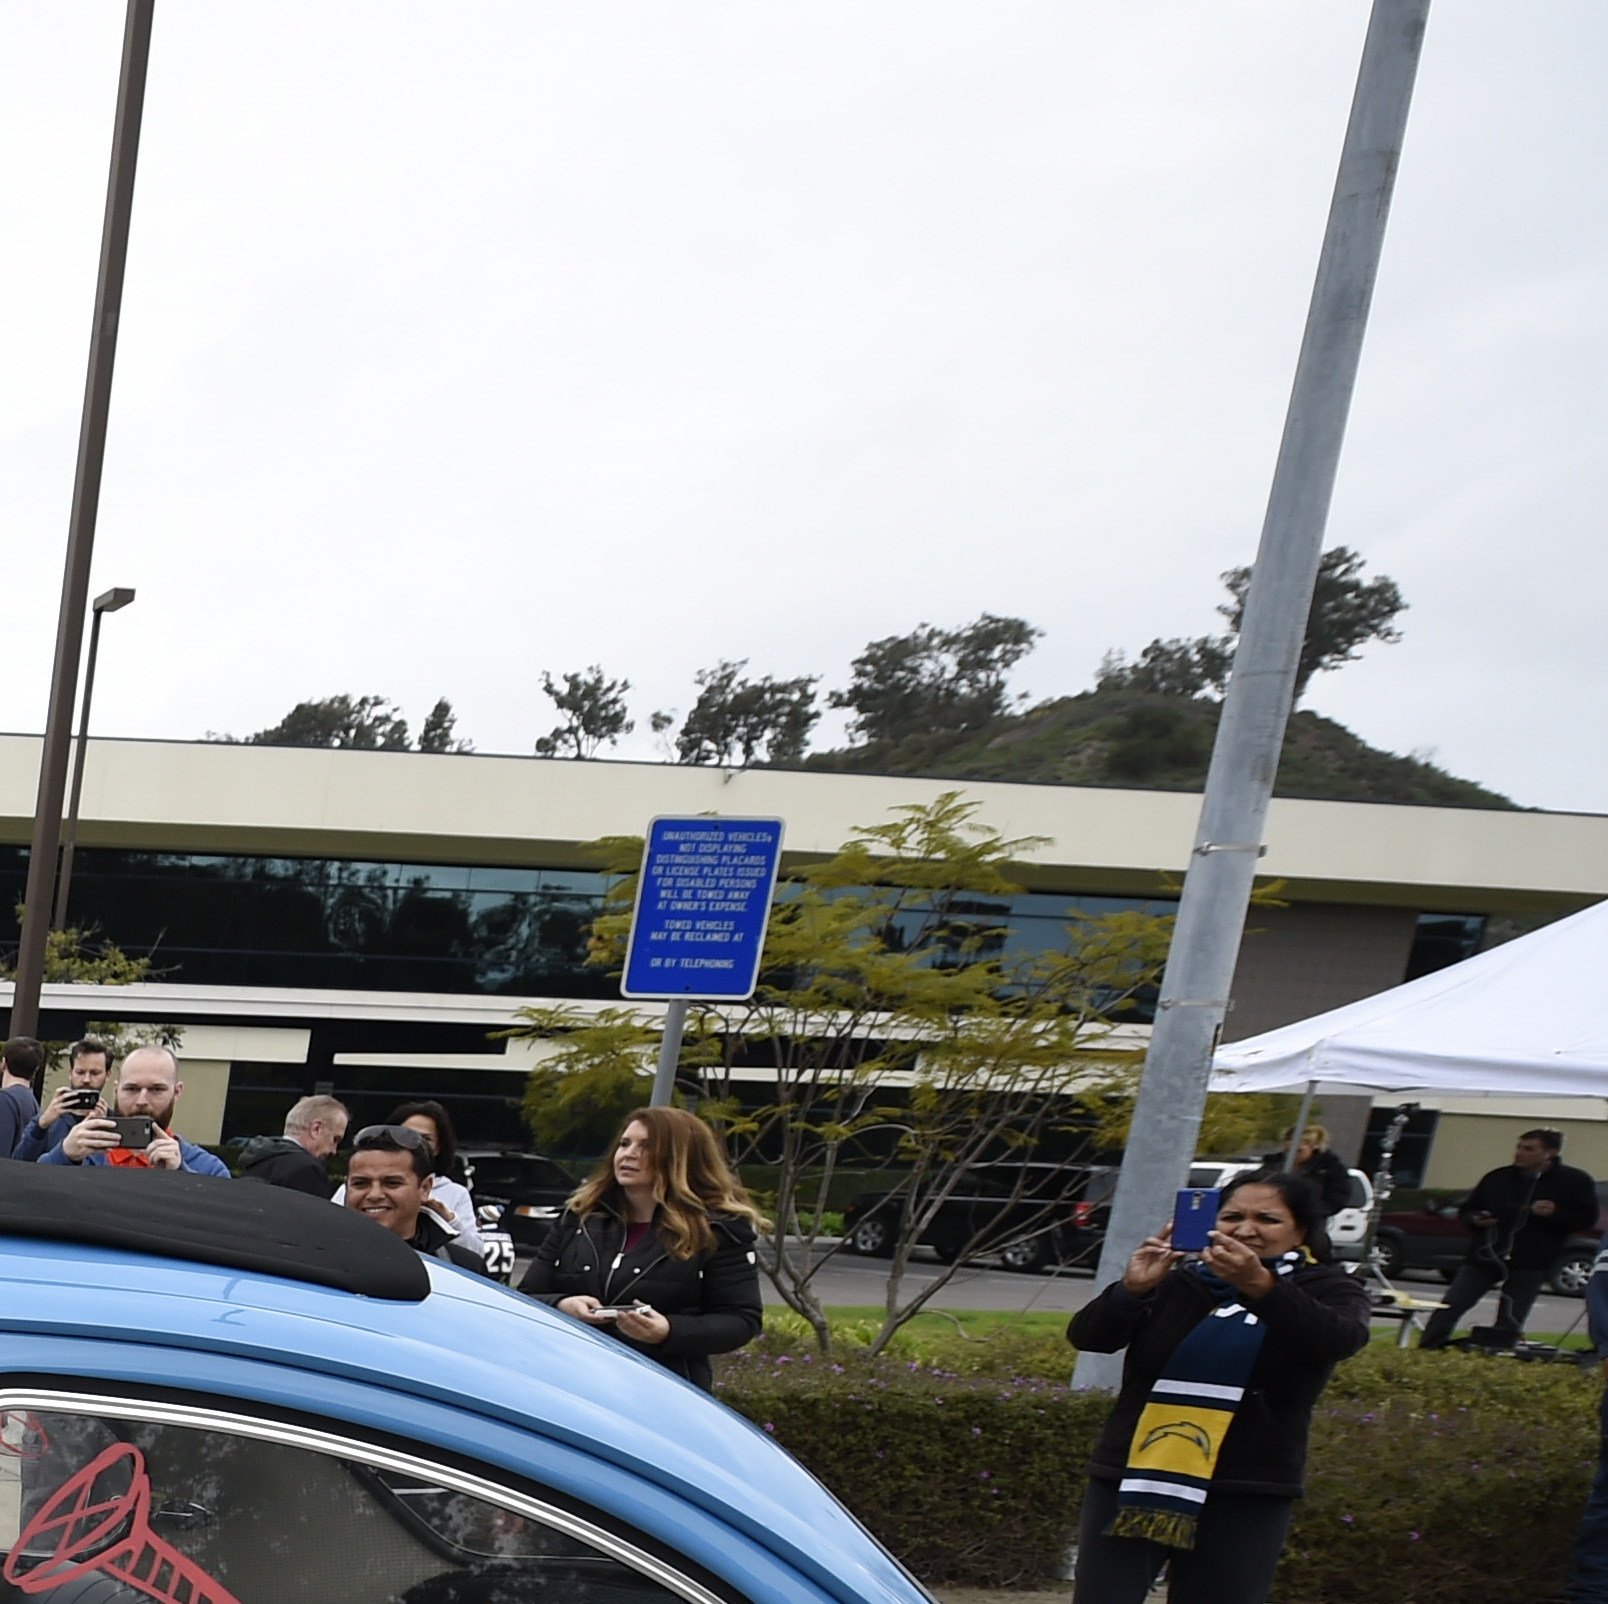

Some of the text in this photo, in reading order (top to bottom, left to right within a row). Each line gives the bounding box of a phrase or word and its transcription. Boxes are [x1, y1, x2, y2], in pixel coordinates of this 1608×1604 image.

[662, 831, 725, 841] UNAUTHORIZED
[679, 843, 747, 853] NOT DISPLAYING
[656, 854, 766, 865] DISTINGUISHING PLACARDS
[652, 866, 767, 877] OR LICENSE PLATES ISSUED
[657, 877, 758, 888] FOR DISABLED PERSONS
[659, 889, 750, 900] WILL BE TOWED AWAY
[657, 901, 667, 910] AT
[670, 901, 706, 911] OWNER'S
[665, 919, 735, 931] TOWED VEHICLES
[650, 931, 744, 942] MAY BE RECLAIMED AT
[650, 957, 734, 968] OR BY TELEPHONING
[484, 1241, 515, 1273] 25
